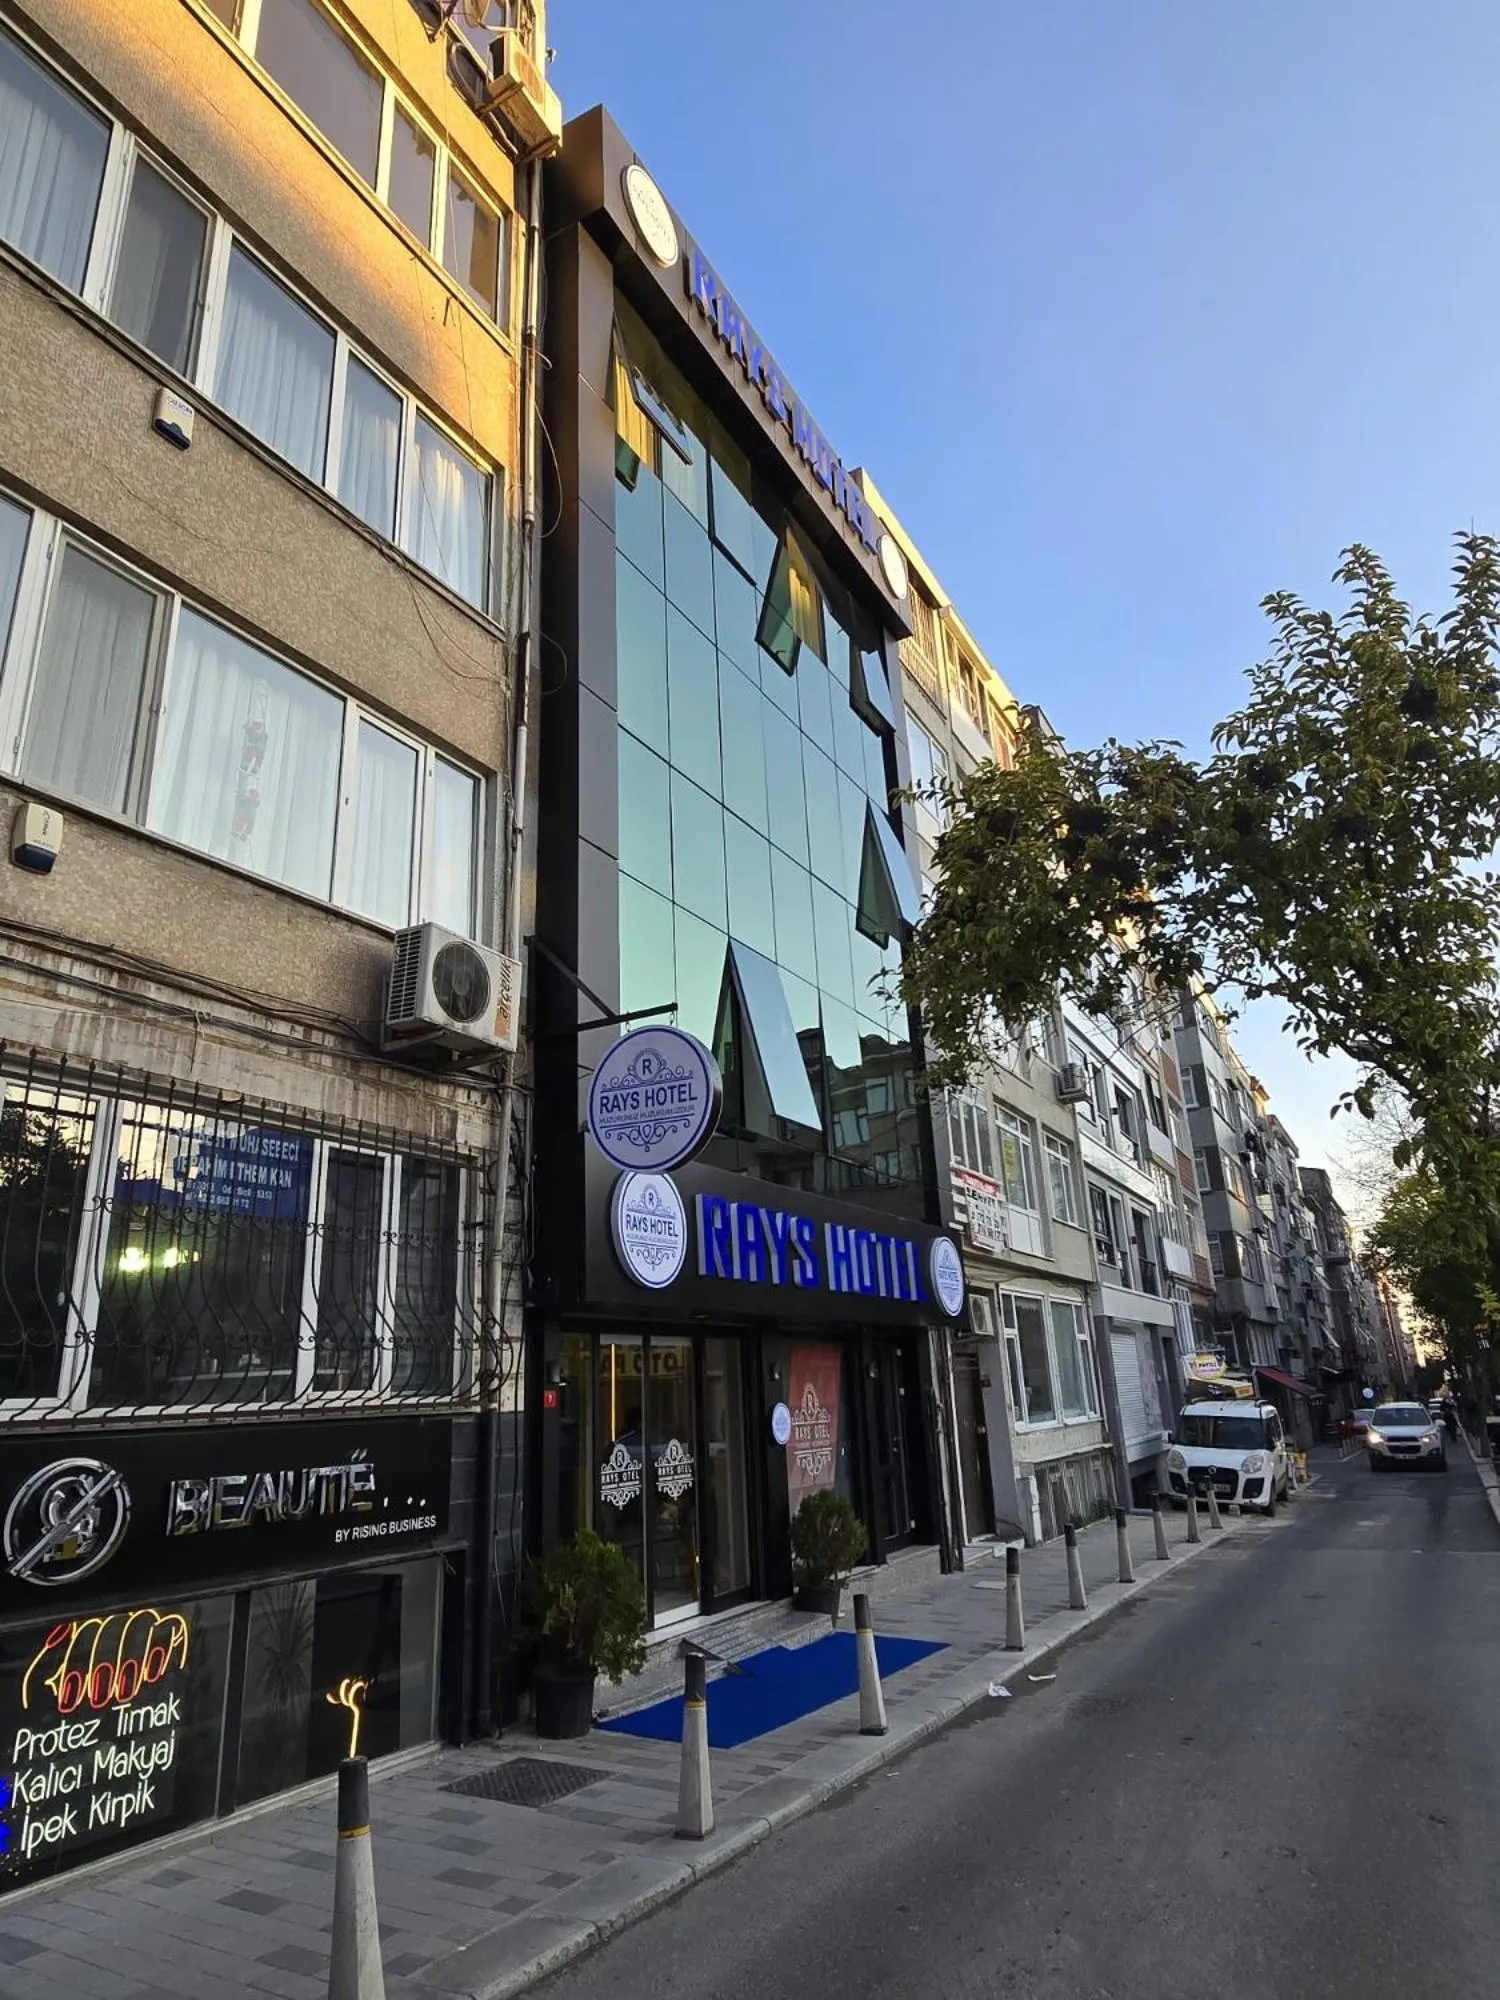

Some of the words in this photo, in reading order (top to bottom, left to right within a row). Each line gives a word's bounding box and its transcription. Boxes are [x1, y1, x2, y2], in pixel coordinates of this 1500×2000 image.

[690, 250, 787, 424] RAYS
[642, 1058, 653, 1076] R
[600, 1090, 640, 1114] RAYS
[644, 1082, 698, 1108] HOTEL
[625, 1213, 649, 1233] RAYS
[650, 1219, 679, 1238] HOTEL
[695, 1192, 820, 1288] RAYS
[823, 1221, 928, 1302] HOTEL
[335, 1529, 350, 1543] BY
[351, 1522, 388, 1540] RISING
[388, 1515, 437, 1535] BUSINESS
[12, 1719, 101, 1765] Protez
[92, 1729, 176, 1785] Makyaj
[20, 1803, 78, 1860] İpek
[88, 1779, 156, 1830] Kirpik
